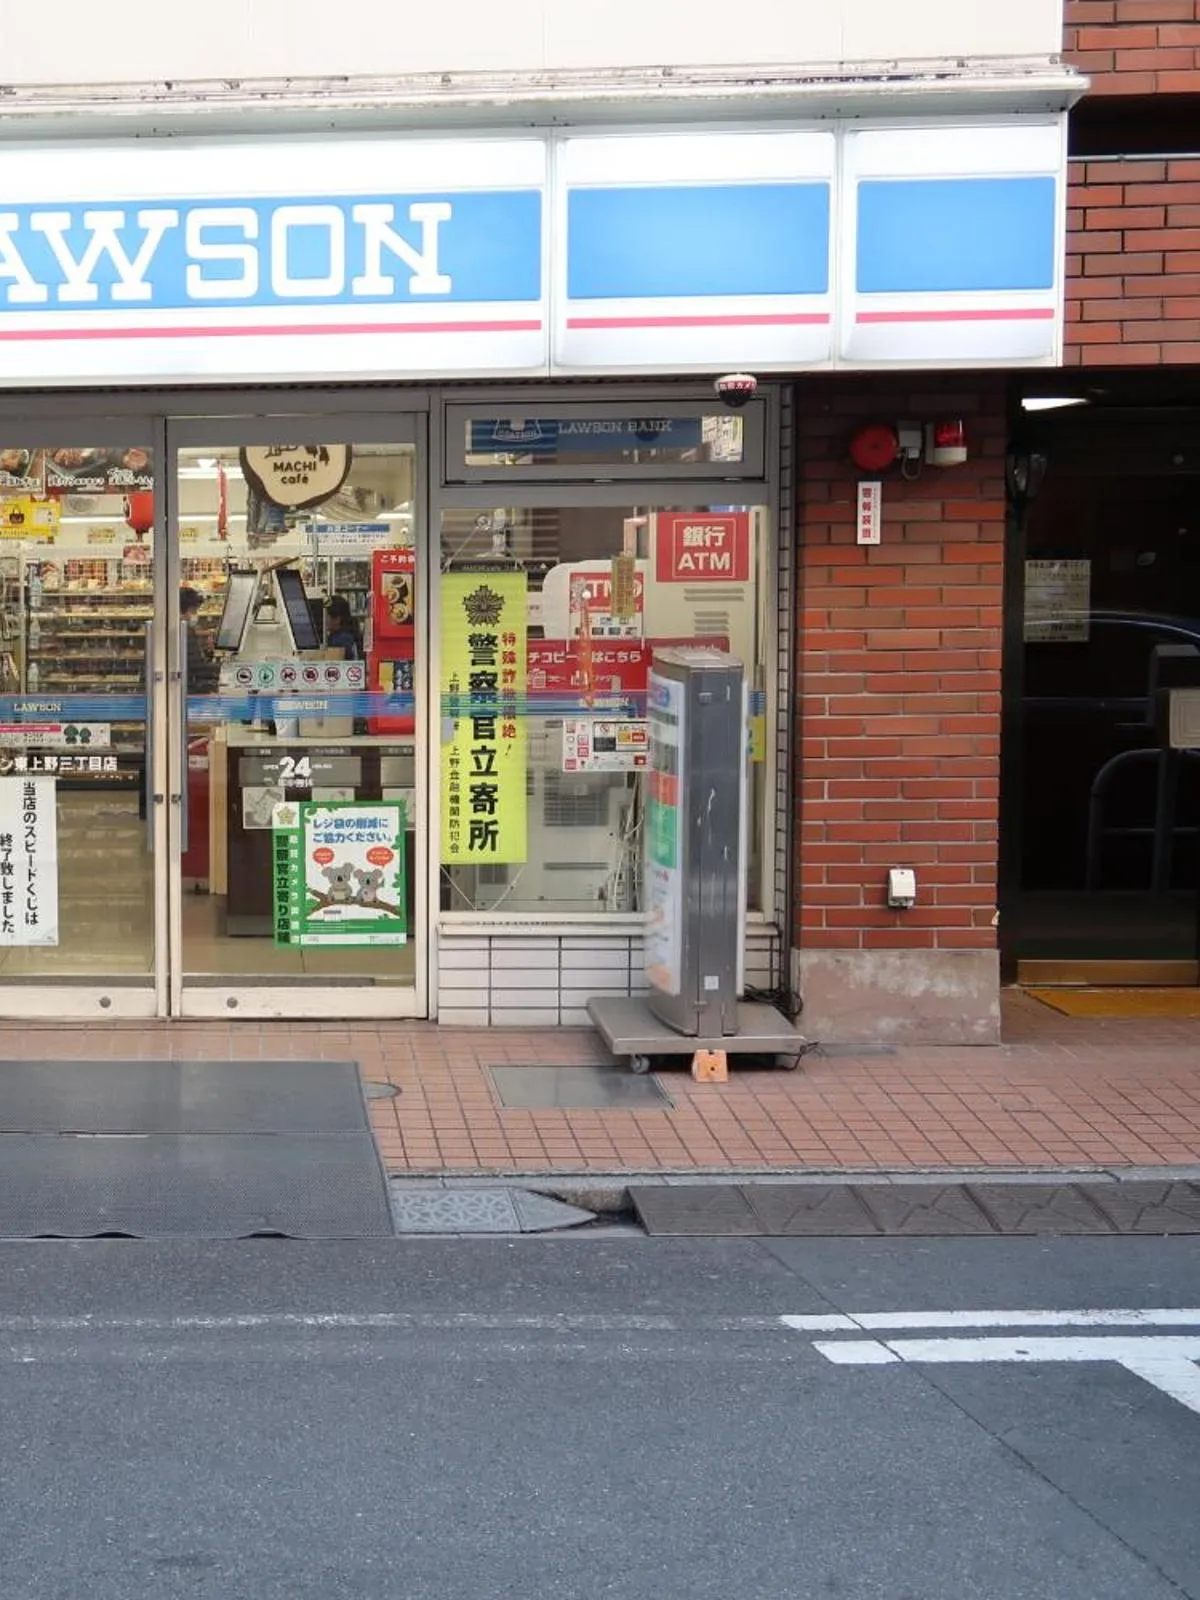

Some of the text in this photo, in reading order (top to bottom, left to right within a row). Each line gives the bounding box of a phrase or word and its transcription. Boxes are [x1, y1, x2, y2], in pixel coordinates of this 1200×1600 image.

[273, 461, 317, 473] MACHI
[281, 474, 309, 485] café
[683, 526, 726, 547] 銀行
[677, 552, 731, 571] ATM
[528, 650, 642, 664] チコピーはこちら
[13, 703, 62, 712] LAWSON
[279, 756, 311, 777] 24
[313, 818, 389, 829] レジ袋の削減に
[23, 782, 39, 926] 当店のスピードくじは
